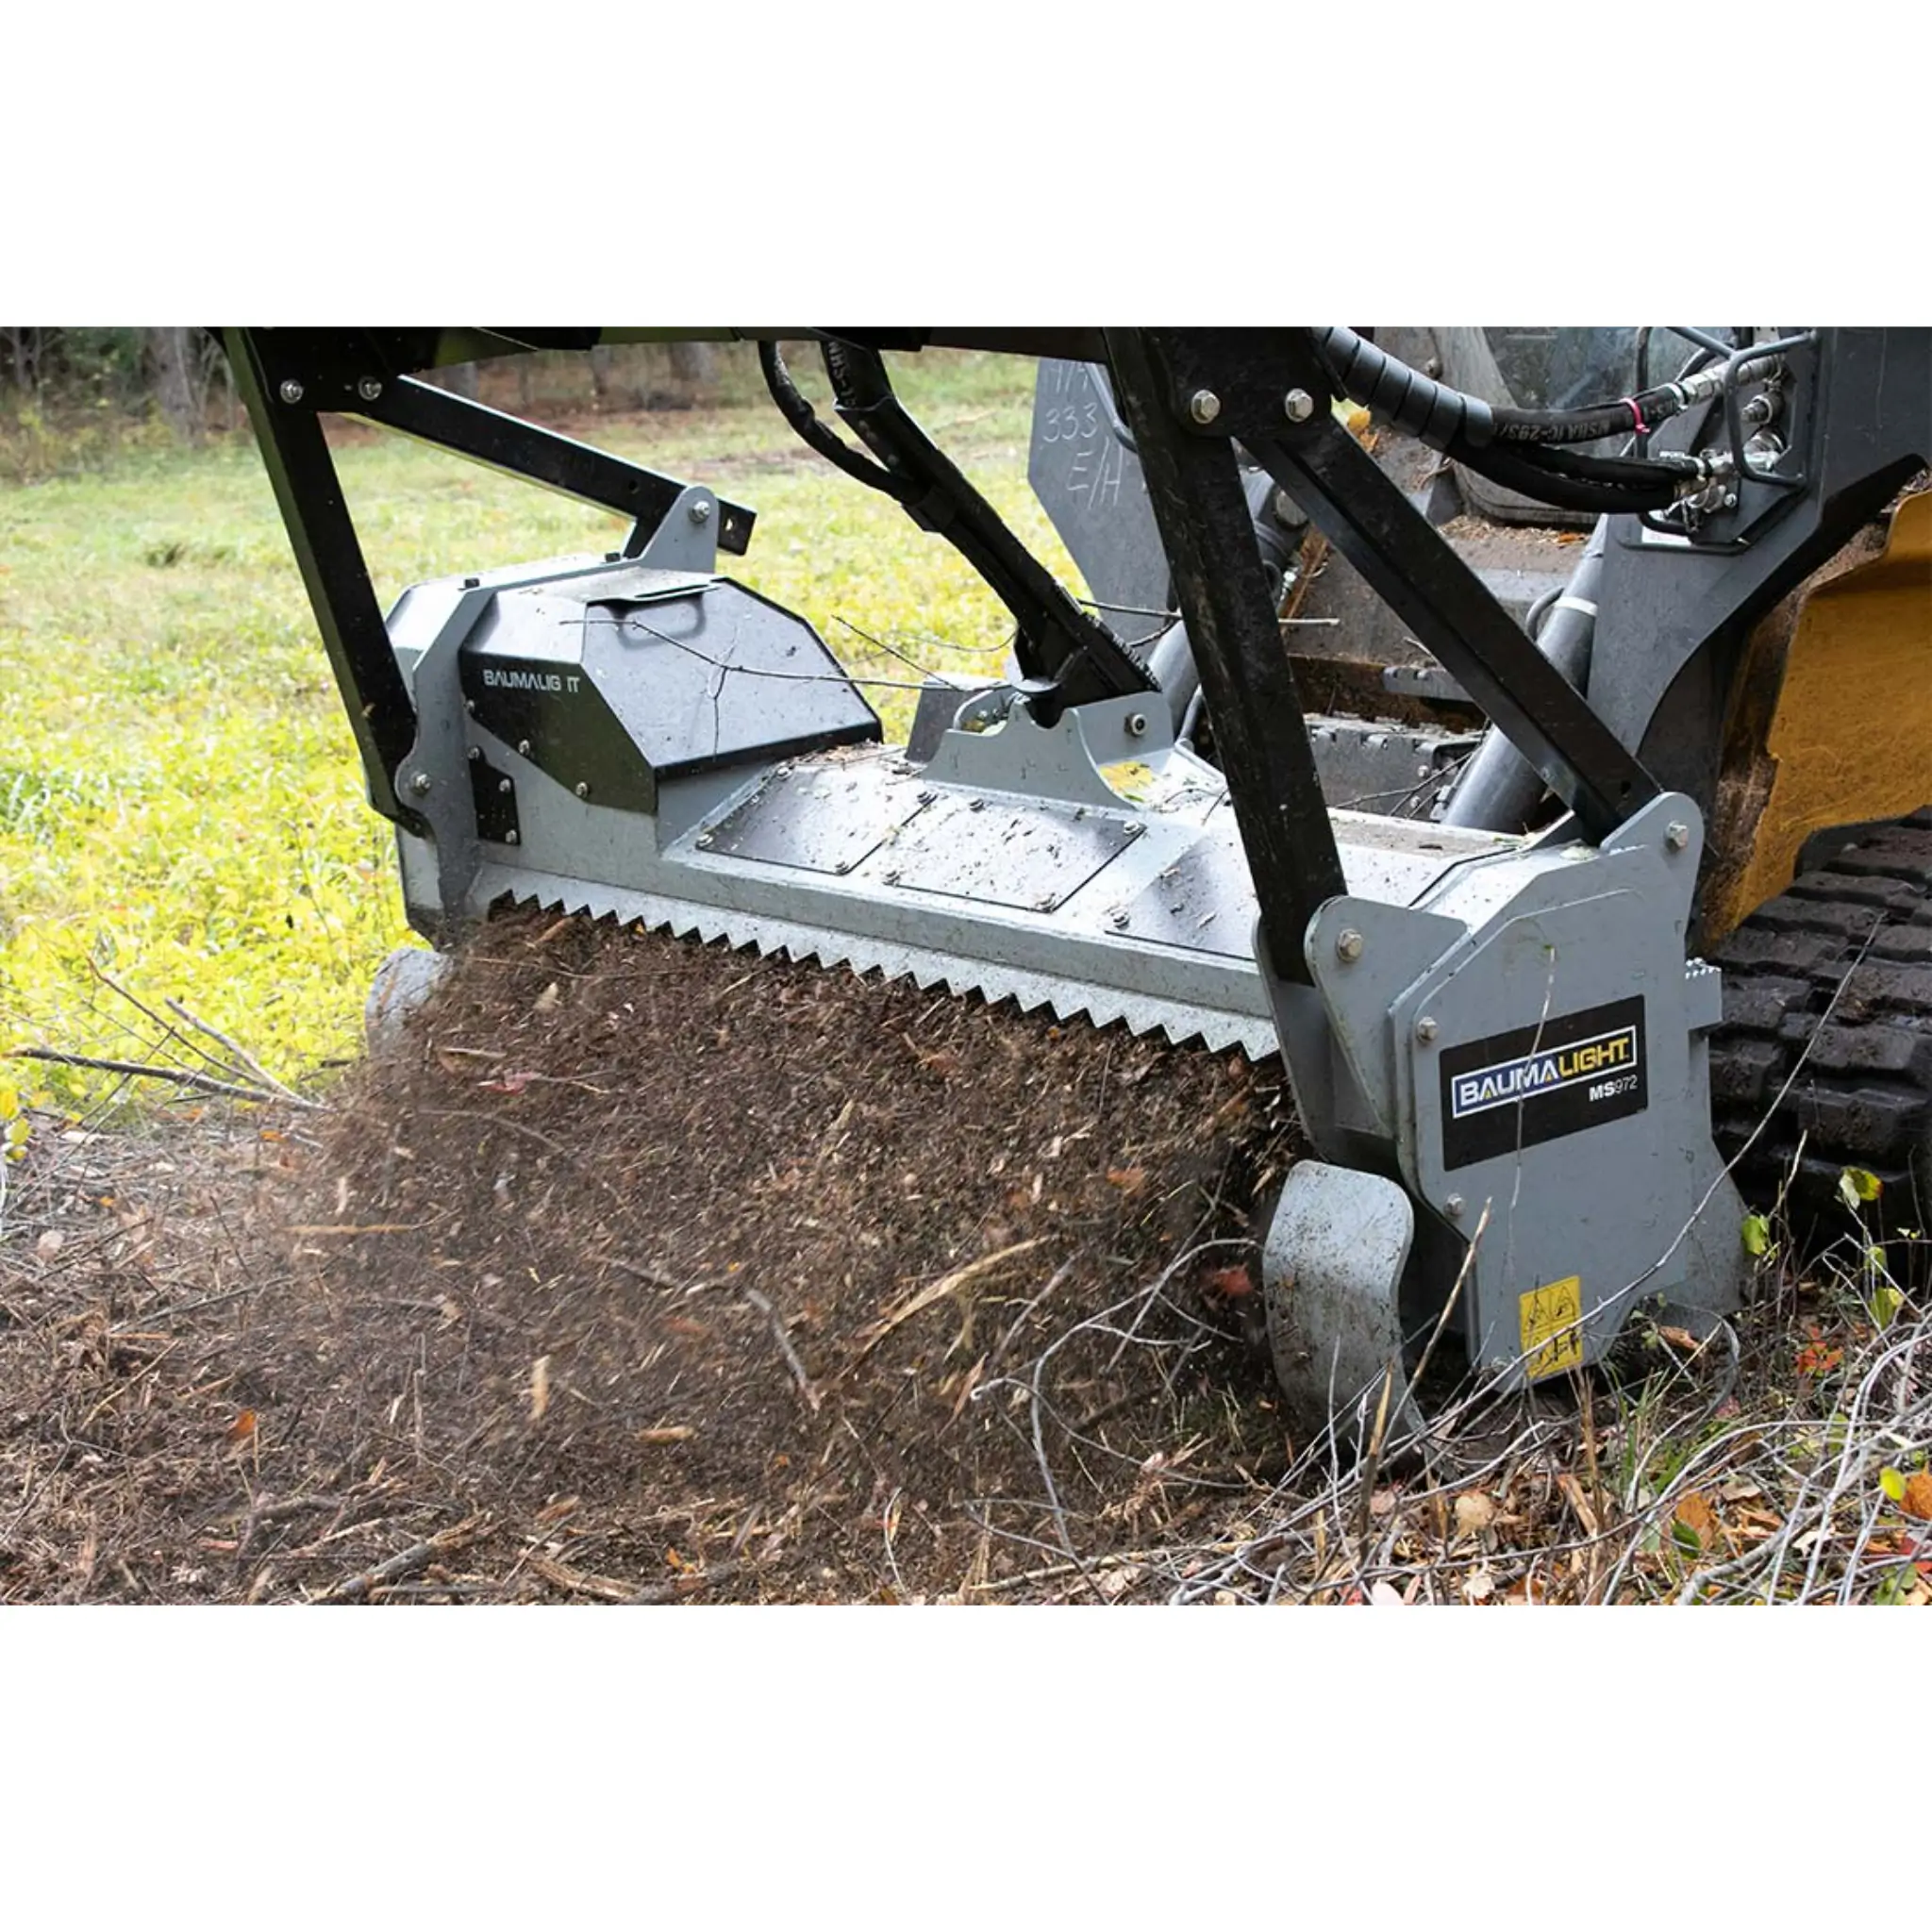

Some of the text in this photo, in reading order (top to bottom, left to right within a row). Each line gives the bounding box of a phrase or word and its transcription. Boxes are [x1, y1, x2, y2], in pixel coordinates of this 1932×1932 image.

[1042, 402, 1099, 442] 333
[1066, 436, 1124, 510] E/H
[1460, 1037, 1630, 1107] BAUMALIGHT
[1589, 1074, 1639, 1103] MS972
